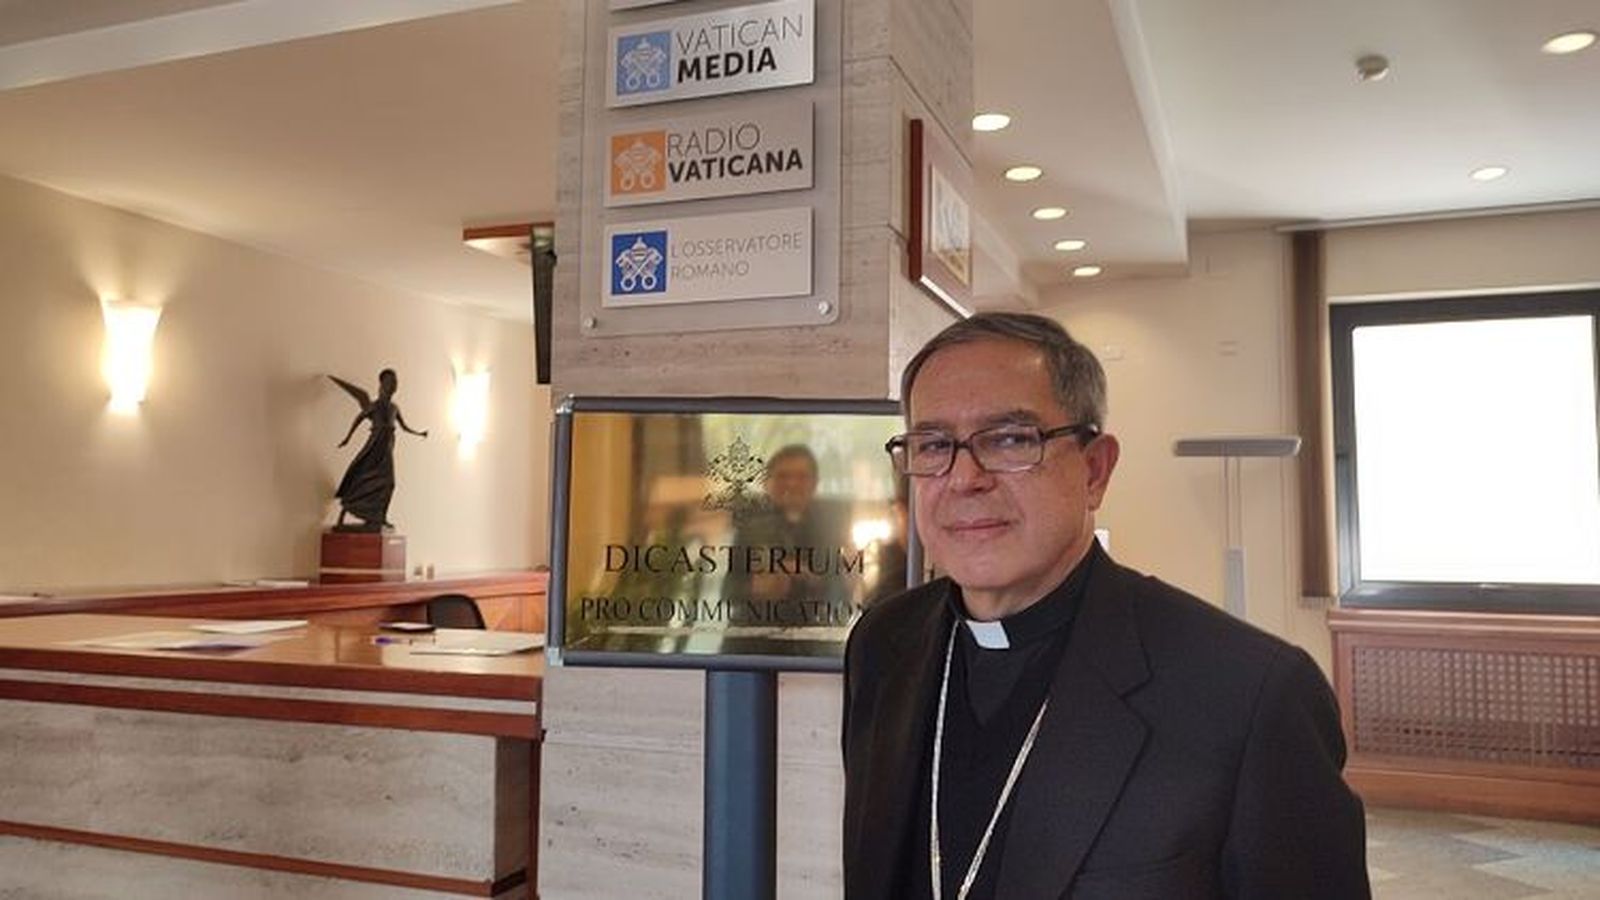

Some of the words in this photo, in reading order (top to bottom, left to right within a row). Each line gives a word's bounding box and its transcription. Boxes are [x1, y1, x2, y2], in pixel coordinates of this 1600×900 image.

[676, 16, 803, 54] VATICAN
[677, 47, 777, 84] MEDIA
[667, 122, 760, 158] RADIO
[669, 148, 803, 183] VATICANA
[671, 260, 750, 280] ROMANO
[604, 544, 864, 576] DICASTERIUM
[580, 597, 630, 621] PRO
